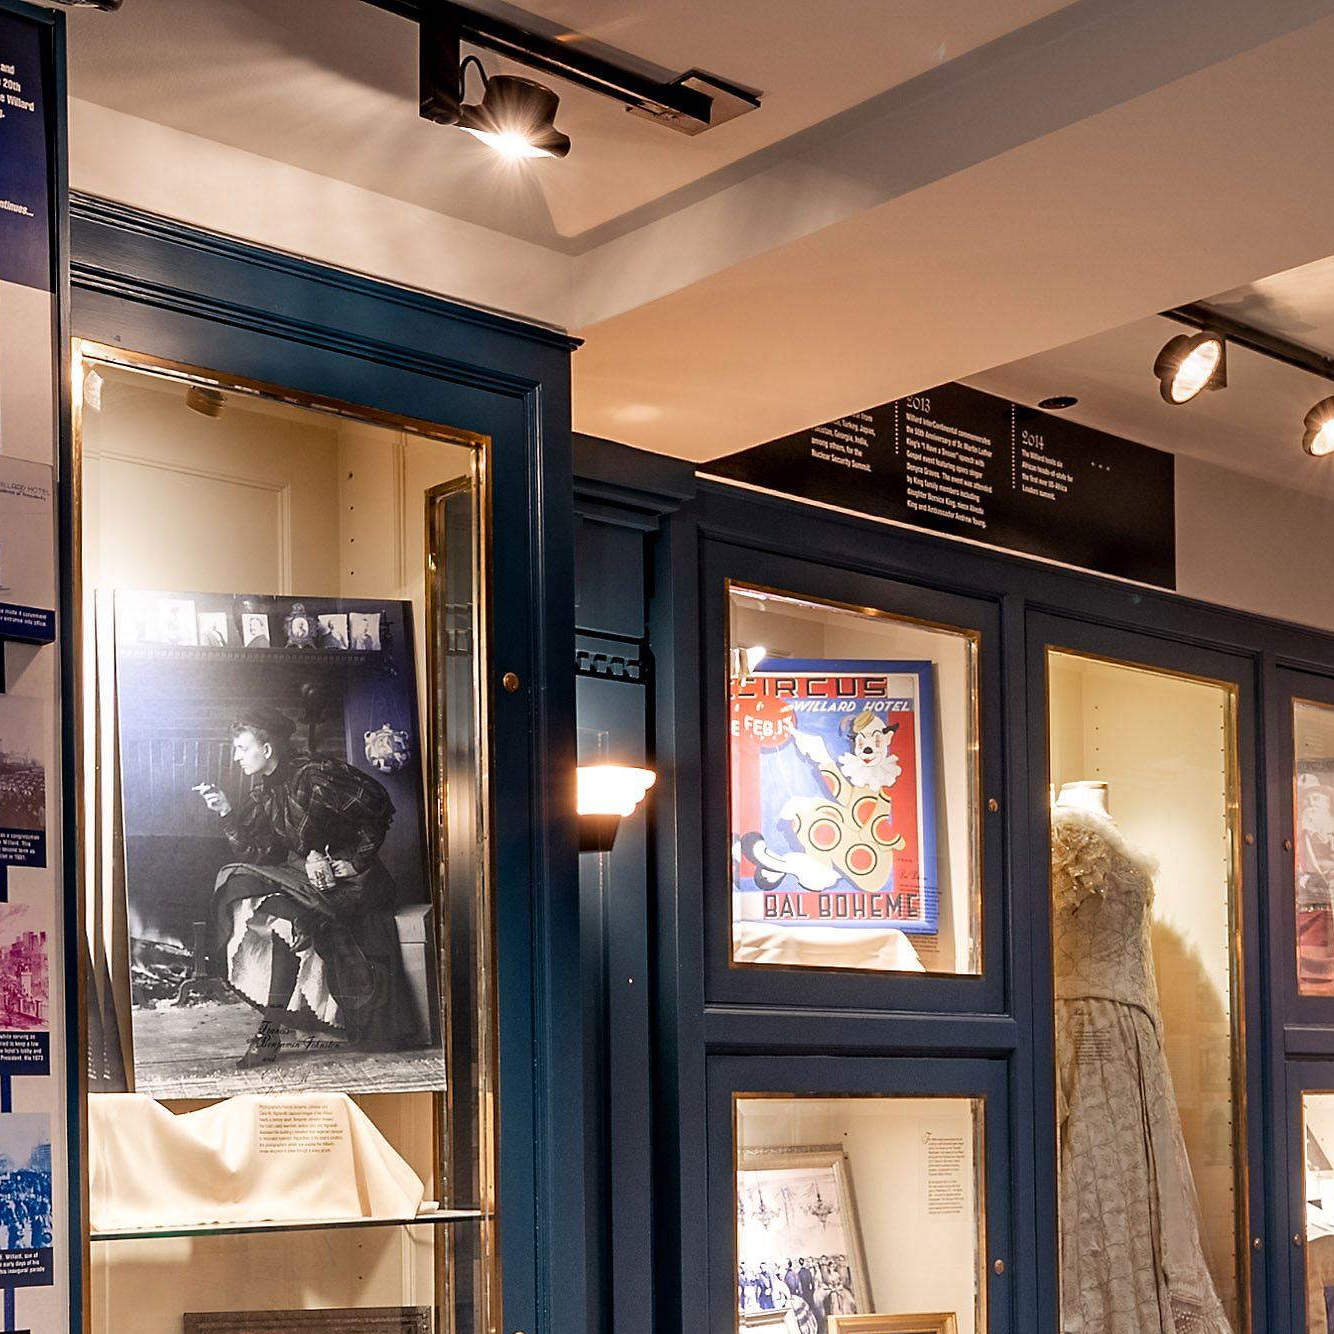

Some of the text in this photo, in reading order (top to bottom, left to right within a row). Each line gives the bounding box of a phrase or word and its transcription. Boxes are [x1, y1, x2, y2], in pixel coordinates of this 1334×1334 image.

[0, 63, 15, 75] and
[3, 78, 21, 93] 20th
[6, 94, 34, 112] Willard
[906, 396, 931, 413] 2013
[1021, 430, 1044, 450] 2014
[793, 701, 910, 712] WILLARD HOTEL
[764, 893, 919, 919] BAL BOHEME
